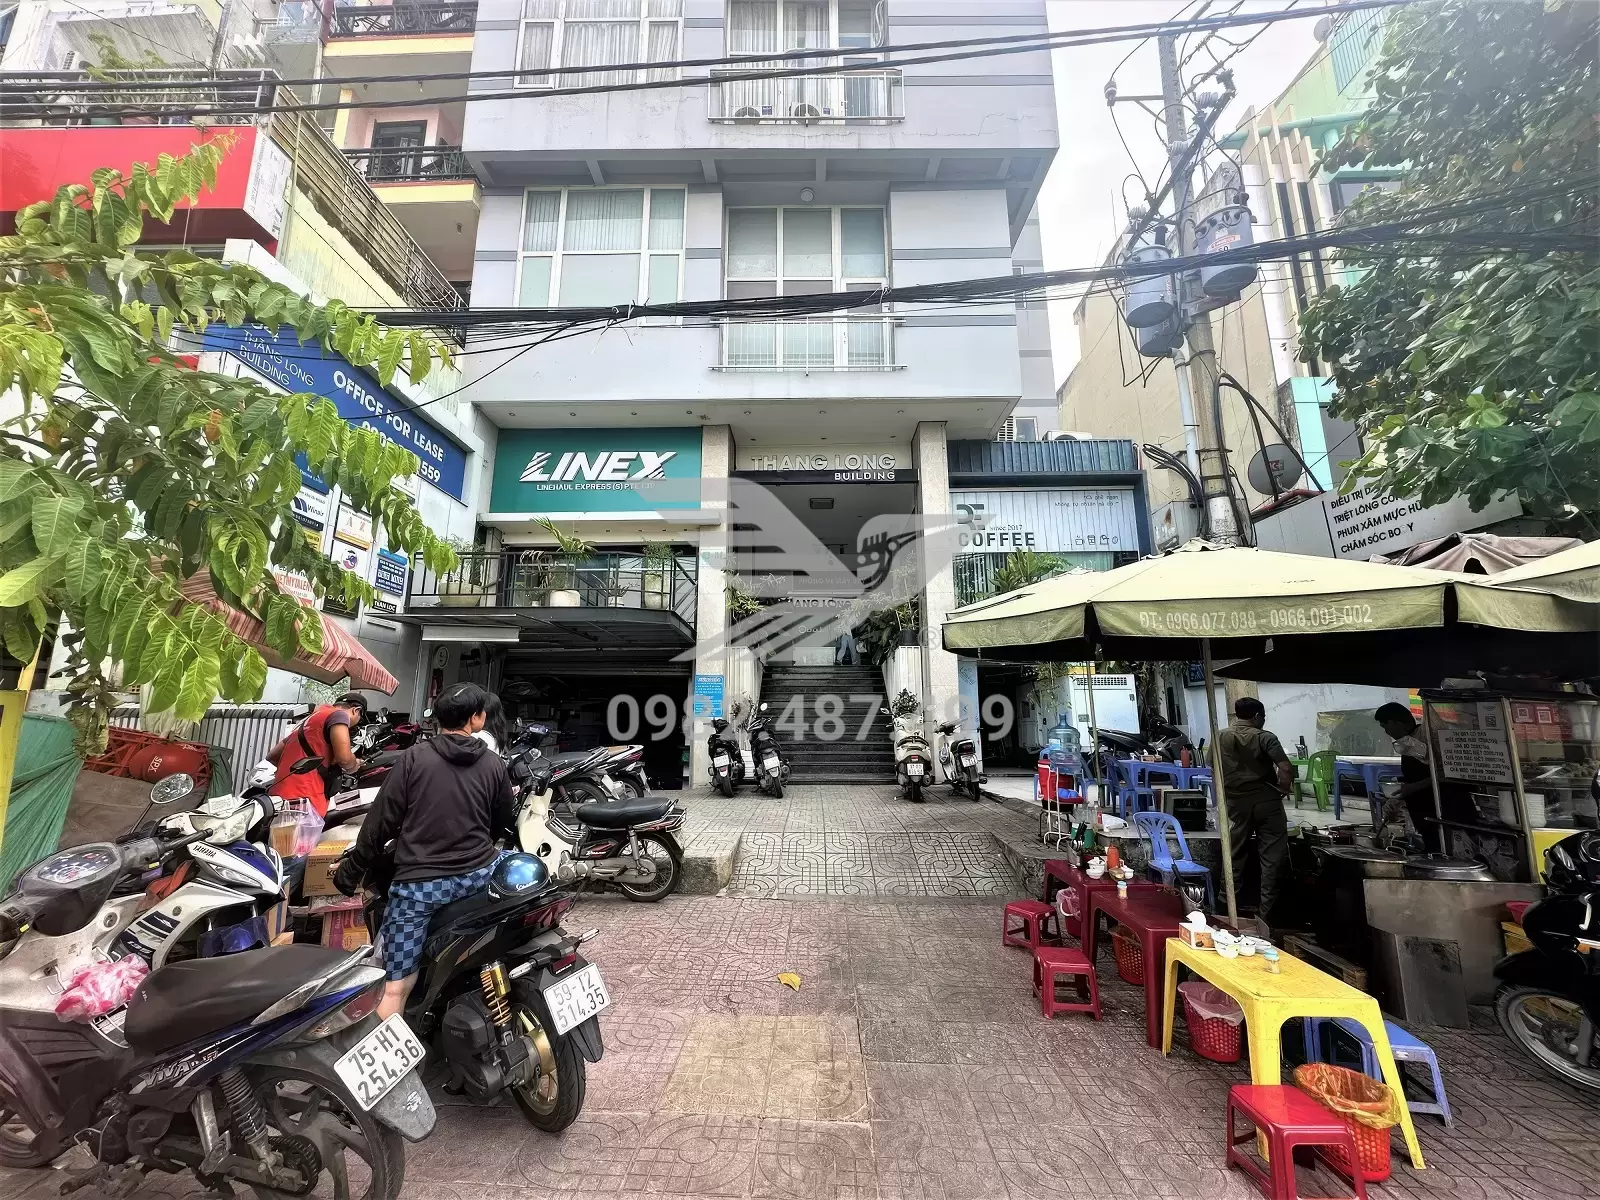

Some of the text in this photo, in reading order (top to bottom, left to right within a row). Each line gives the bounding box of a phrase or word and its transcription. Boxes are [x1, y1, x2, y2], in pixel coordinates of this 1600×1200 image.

[239, 344, 290, 385] BUILDING
[284, 359, 315, 386] LONG
[333, 370, 384, 418] OFFICE
[385, 409, 412, 439] FOR
[413, 429, 444, 462] LEASE
[518, 450, 678, 483] LINEX
[751, 453, 897, 471] THANG LONG
[834, 471, 896, 481] BUILDING
[1337, 524, 1360, 539] PHUN
[1383, 507, 1407, 523] MỰC
[1341, 522, 1414, 553] CHĂM SÓC BOY
[958, 532, 1036, 547] COFFEE
[192, 845, 217, 858] YAMAHA
[552, 971, 595, 1006] 59-T2
[556, 986, 605, 1028] 514.35
[347, 1023, 401, 1076] 75-H1
[357, 1038, 420, 1108] 254.36
